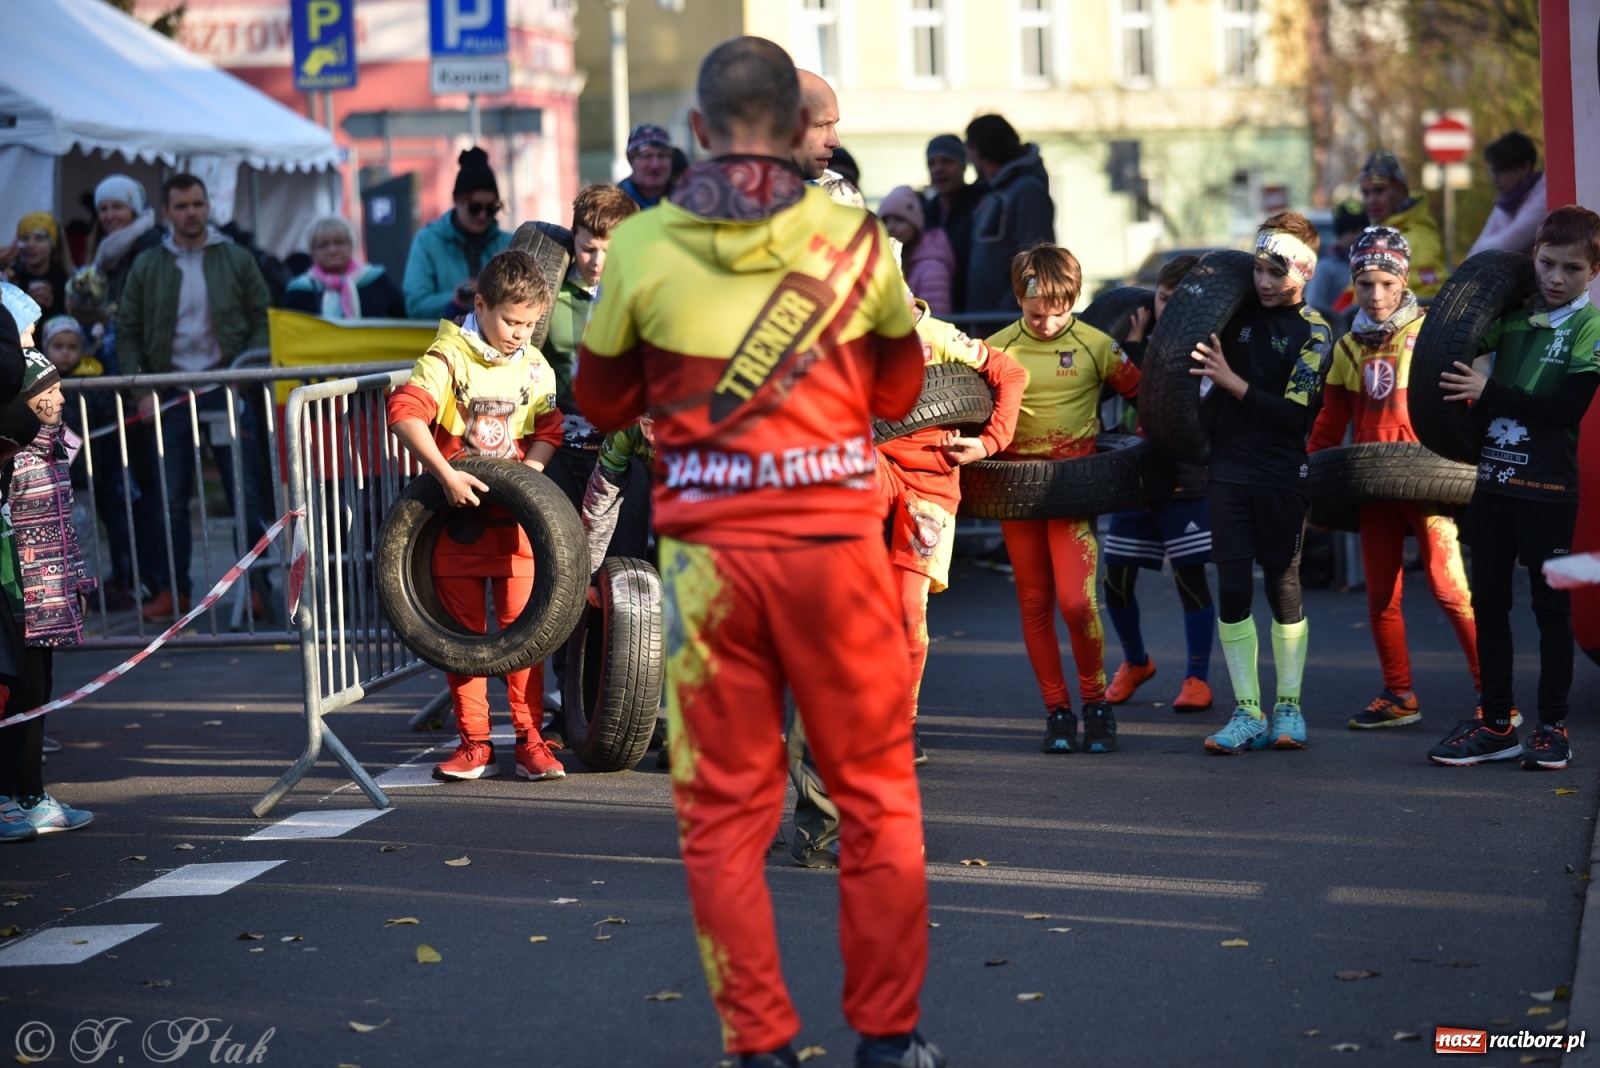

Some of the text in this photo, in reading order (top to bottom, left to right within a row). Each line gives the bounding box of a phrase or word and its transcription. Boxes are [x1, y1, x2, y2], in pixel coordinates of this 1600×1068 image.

[306, 0, 341, 42] P
[443, 0, 493, 50] P
[715, 289, 817, 402] TRENER
[36, 399, 54, 417] 58
[1508, 477, 1565, 491] MASZ-BUD-SERWIS
